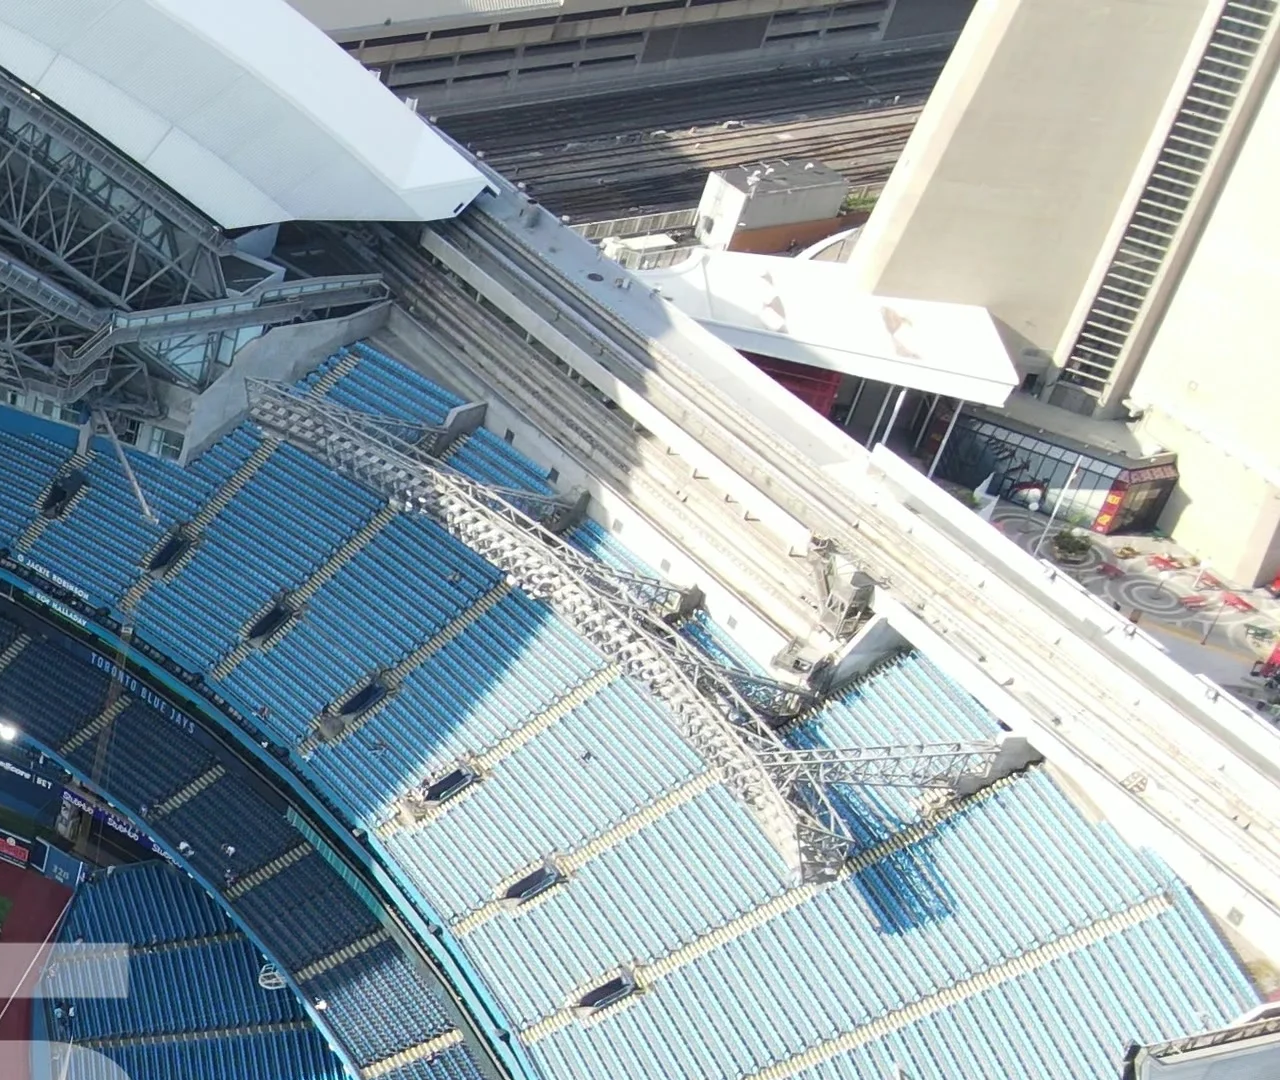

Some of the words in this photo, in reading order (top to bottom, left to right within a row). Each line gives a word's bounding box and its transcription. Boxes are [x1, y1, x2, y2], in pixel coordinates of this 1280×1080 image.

[90, 651, 137, 692] TORONTO
[140, 686, 168, 714] BLUE
[169, 708, 196, 735] JAYS
[36, 776, 53, 790] BET
